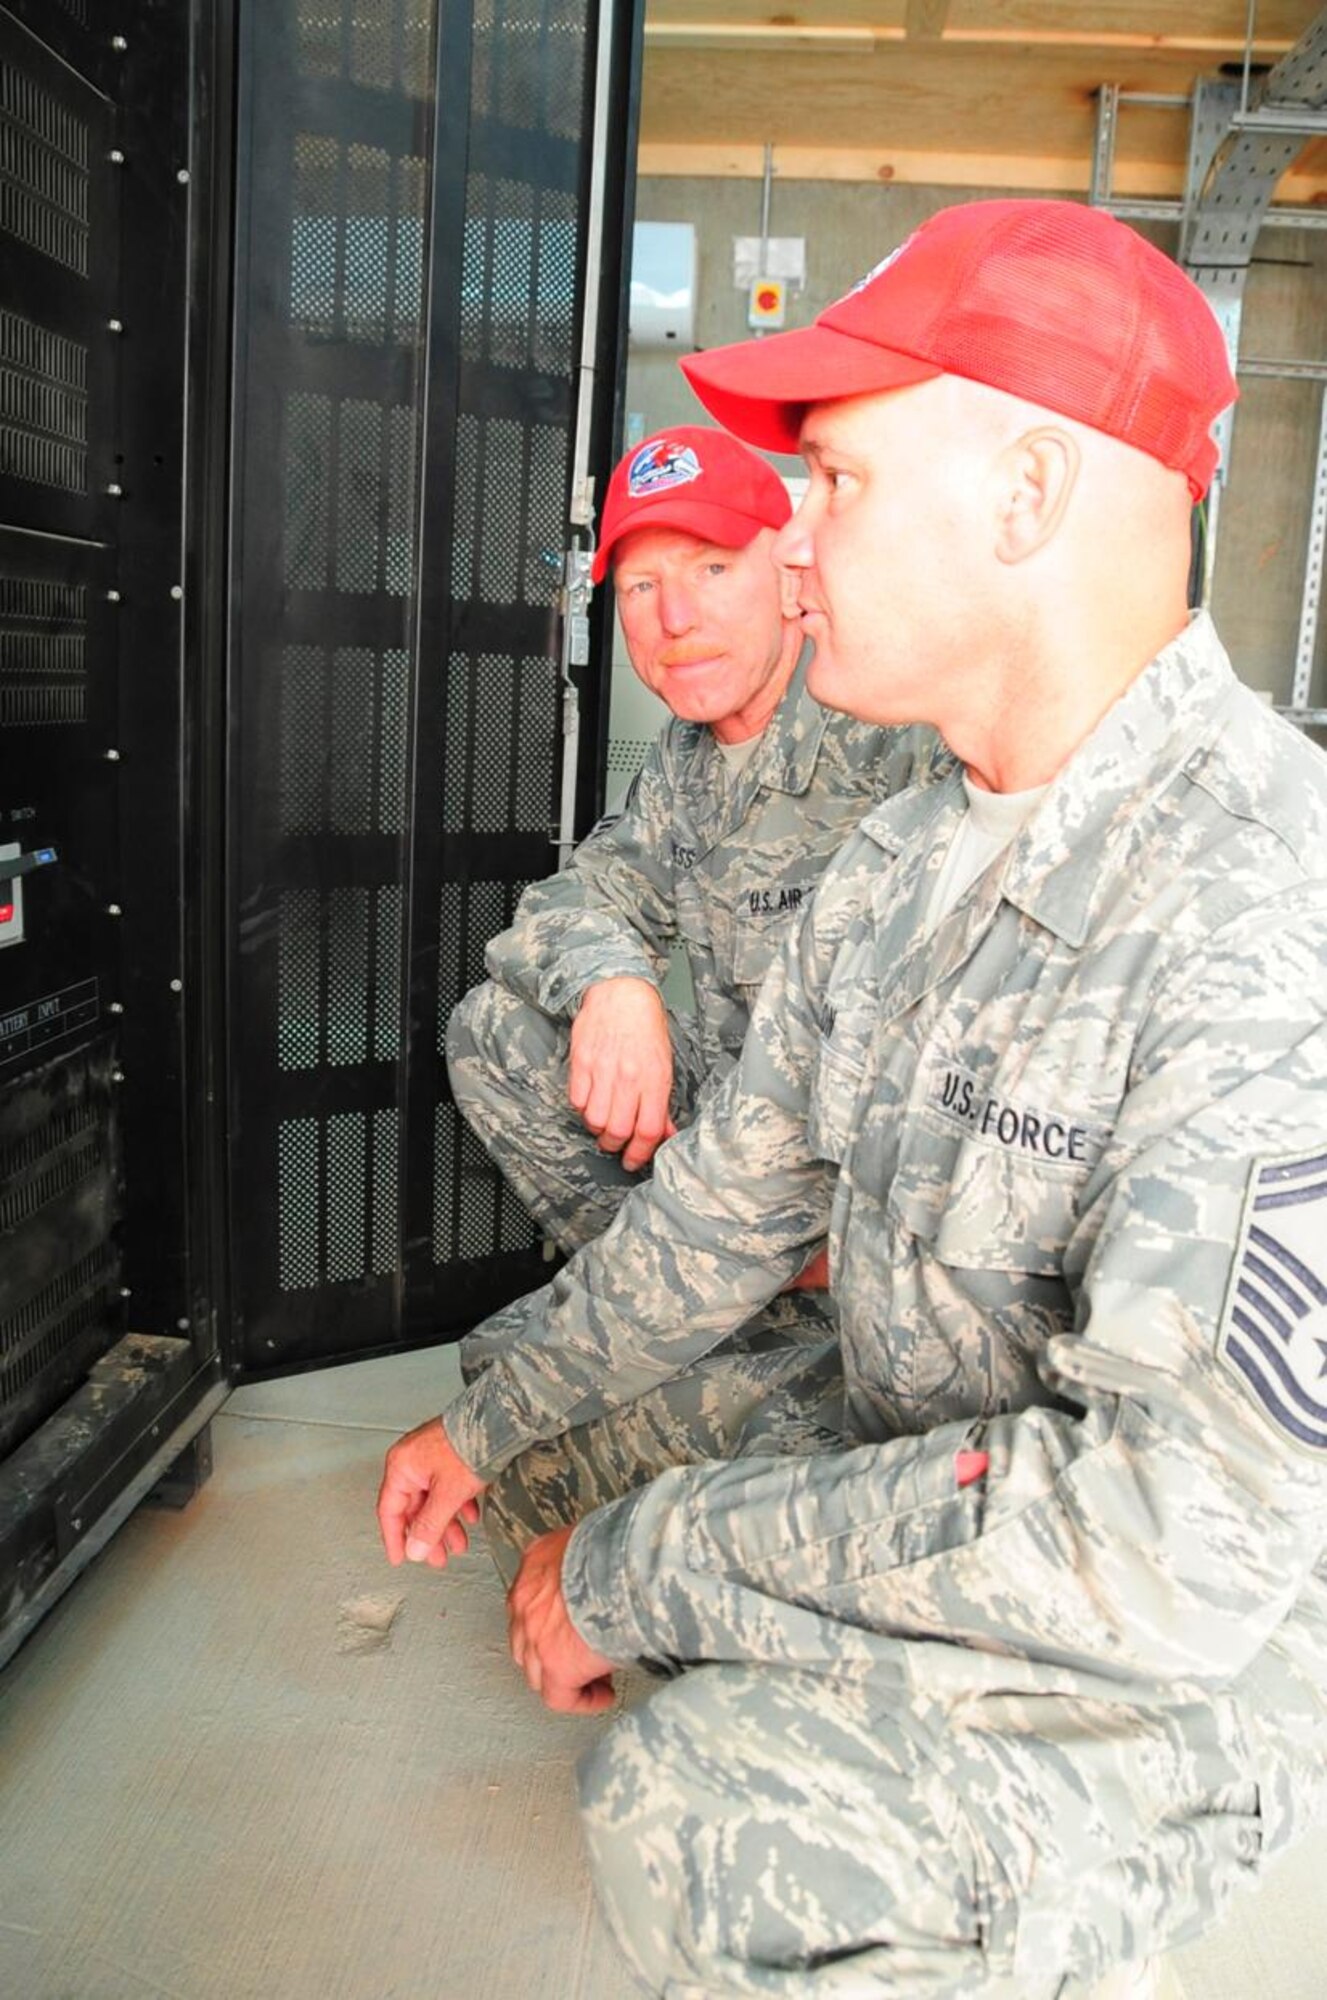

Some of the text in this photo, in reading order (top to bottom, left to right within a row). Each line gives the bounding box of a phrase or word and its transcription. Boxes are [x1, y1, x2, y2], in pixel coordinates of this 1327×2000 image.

[750, 890, 774, 912] U.S.
[778, 887, 804, 910] AIR
[942, 1072, 1087, 1161] U.S. FORCE
